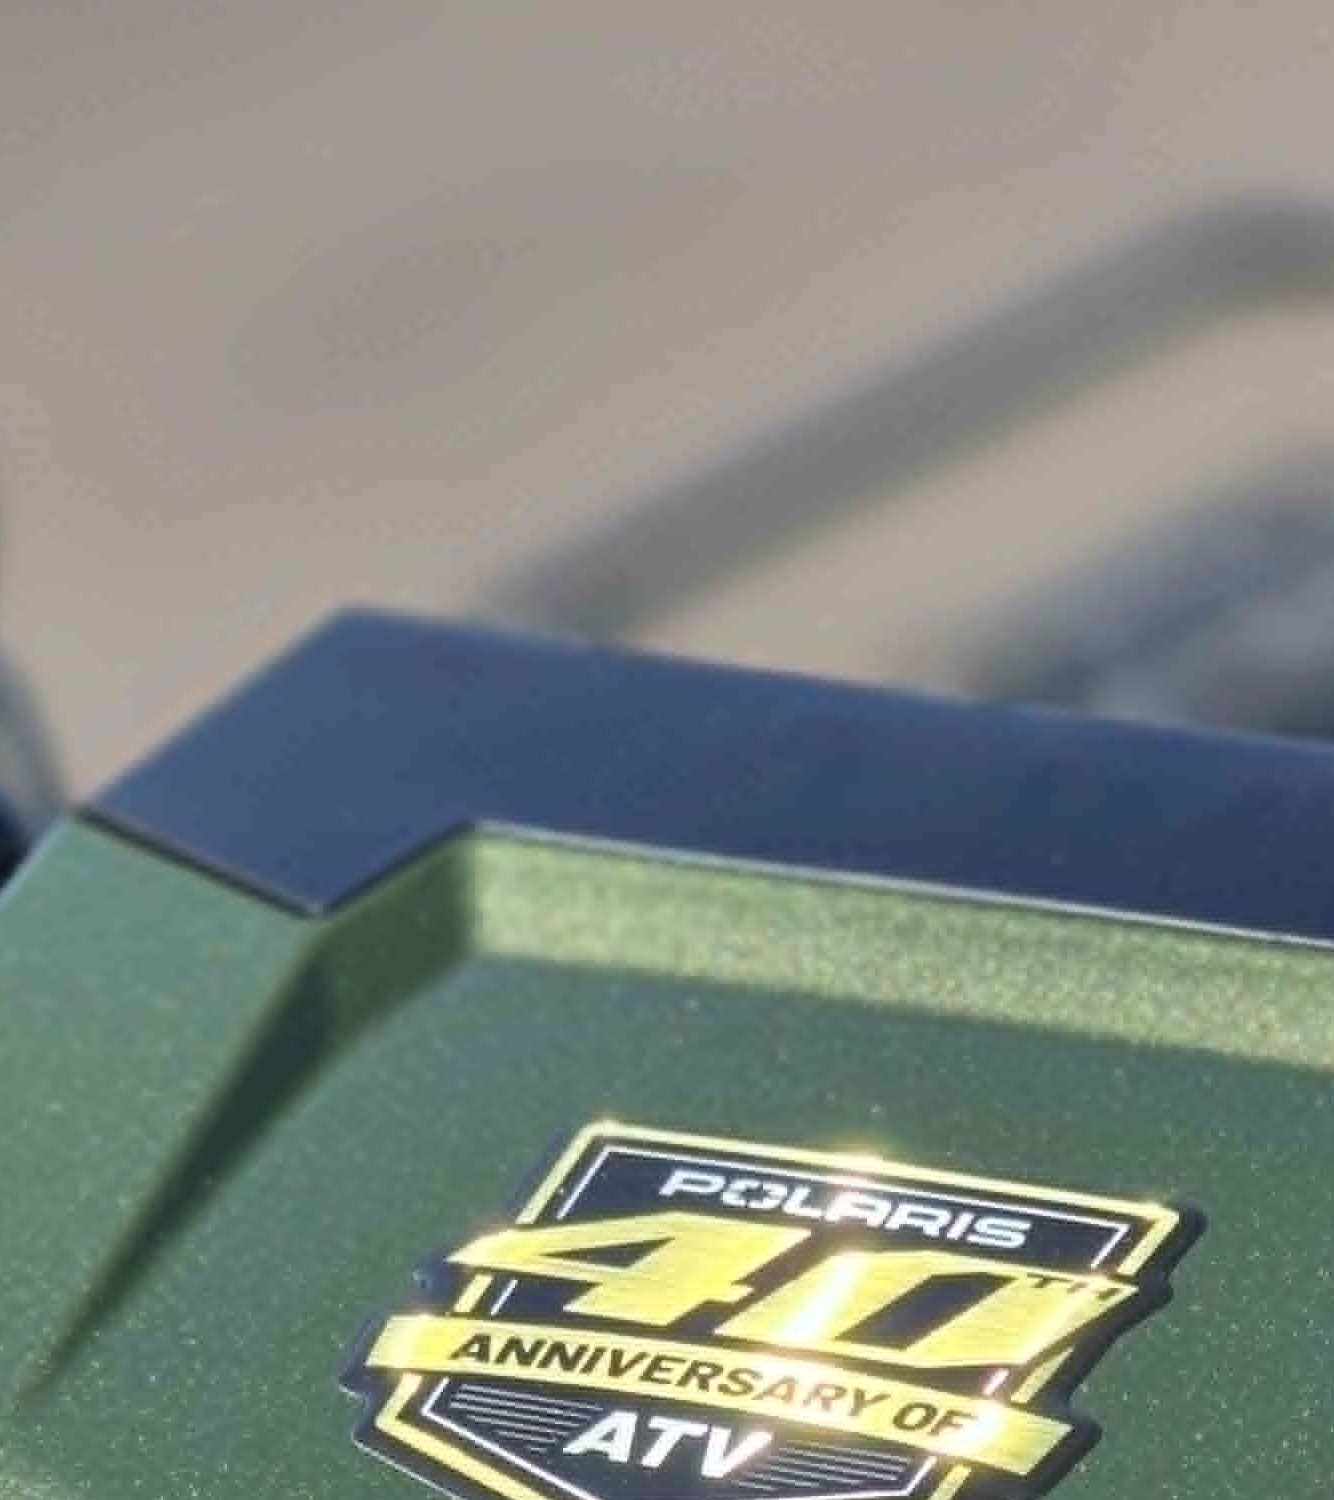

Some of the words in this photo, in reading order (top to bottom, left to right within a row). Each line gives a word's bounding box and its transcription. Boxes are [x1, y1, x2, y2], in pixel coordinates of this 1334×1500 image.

[659, 1169, 1031, 1249] POLARIS
[451, 1334, 889, 1416] ANNIVERSARY
[892, 1401, 979, 1436] OF
[563, 1411, 774, 1478] ATV
